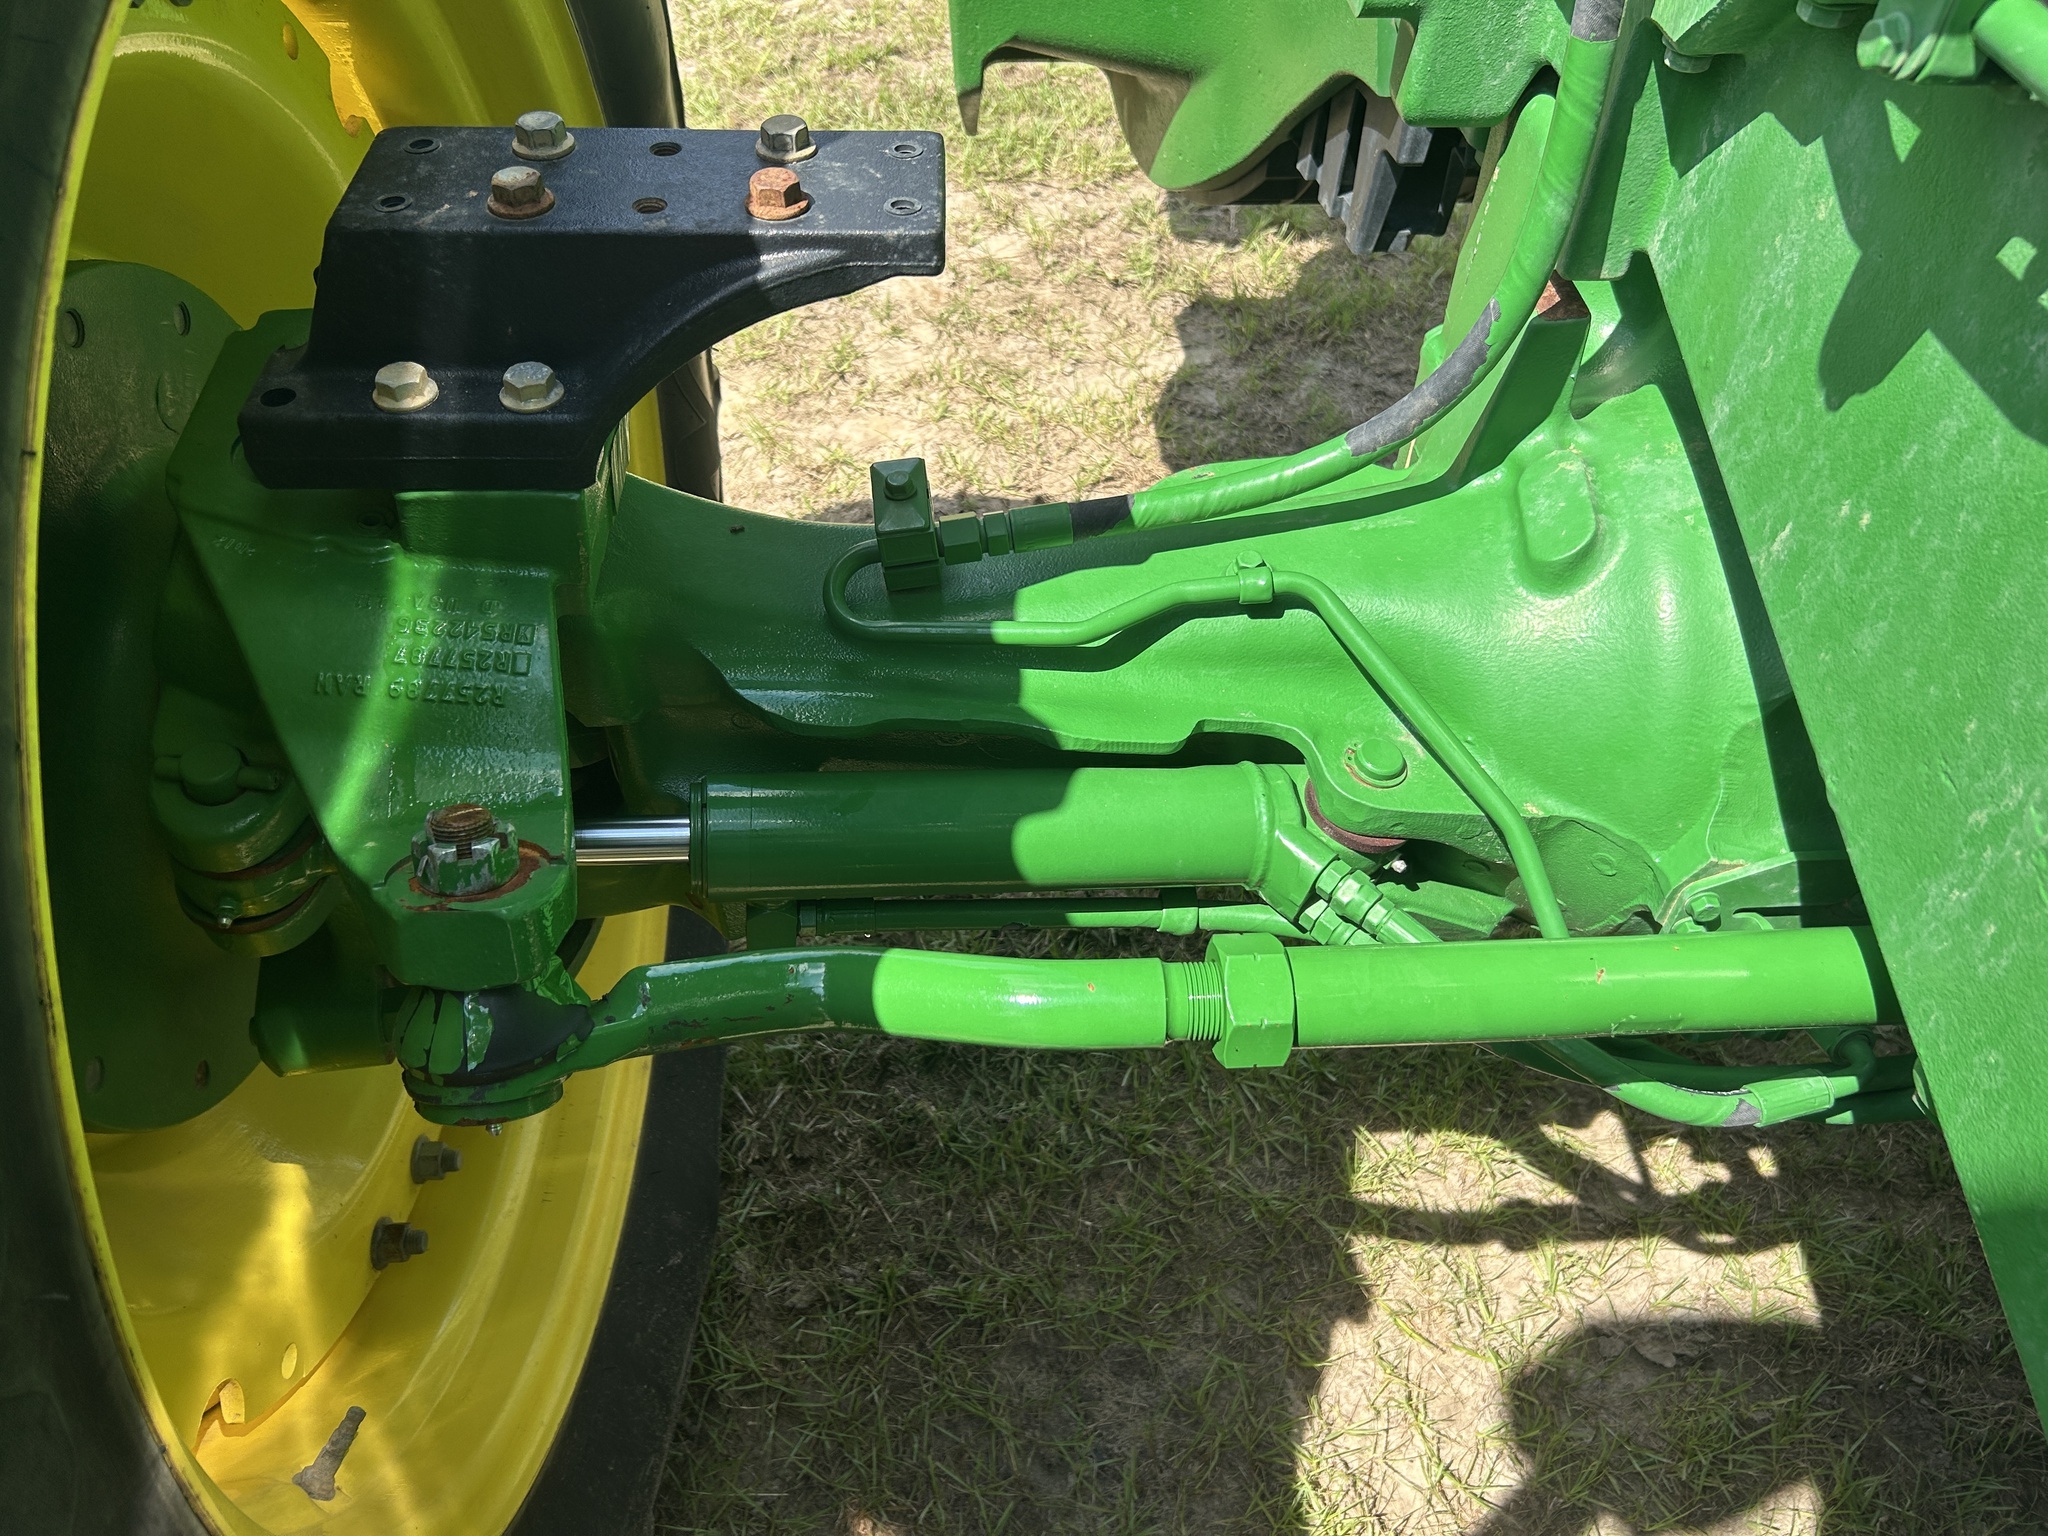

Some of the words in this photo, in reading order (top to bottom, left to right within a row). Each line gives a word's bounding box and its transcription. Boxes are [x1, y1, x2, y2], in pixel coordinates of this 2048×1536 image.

[397, 617, 511, 642] R542236
[393, 646, 512, 674] R257787
[389, 677, 504, 706] R257789
